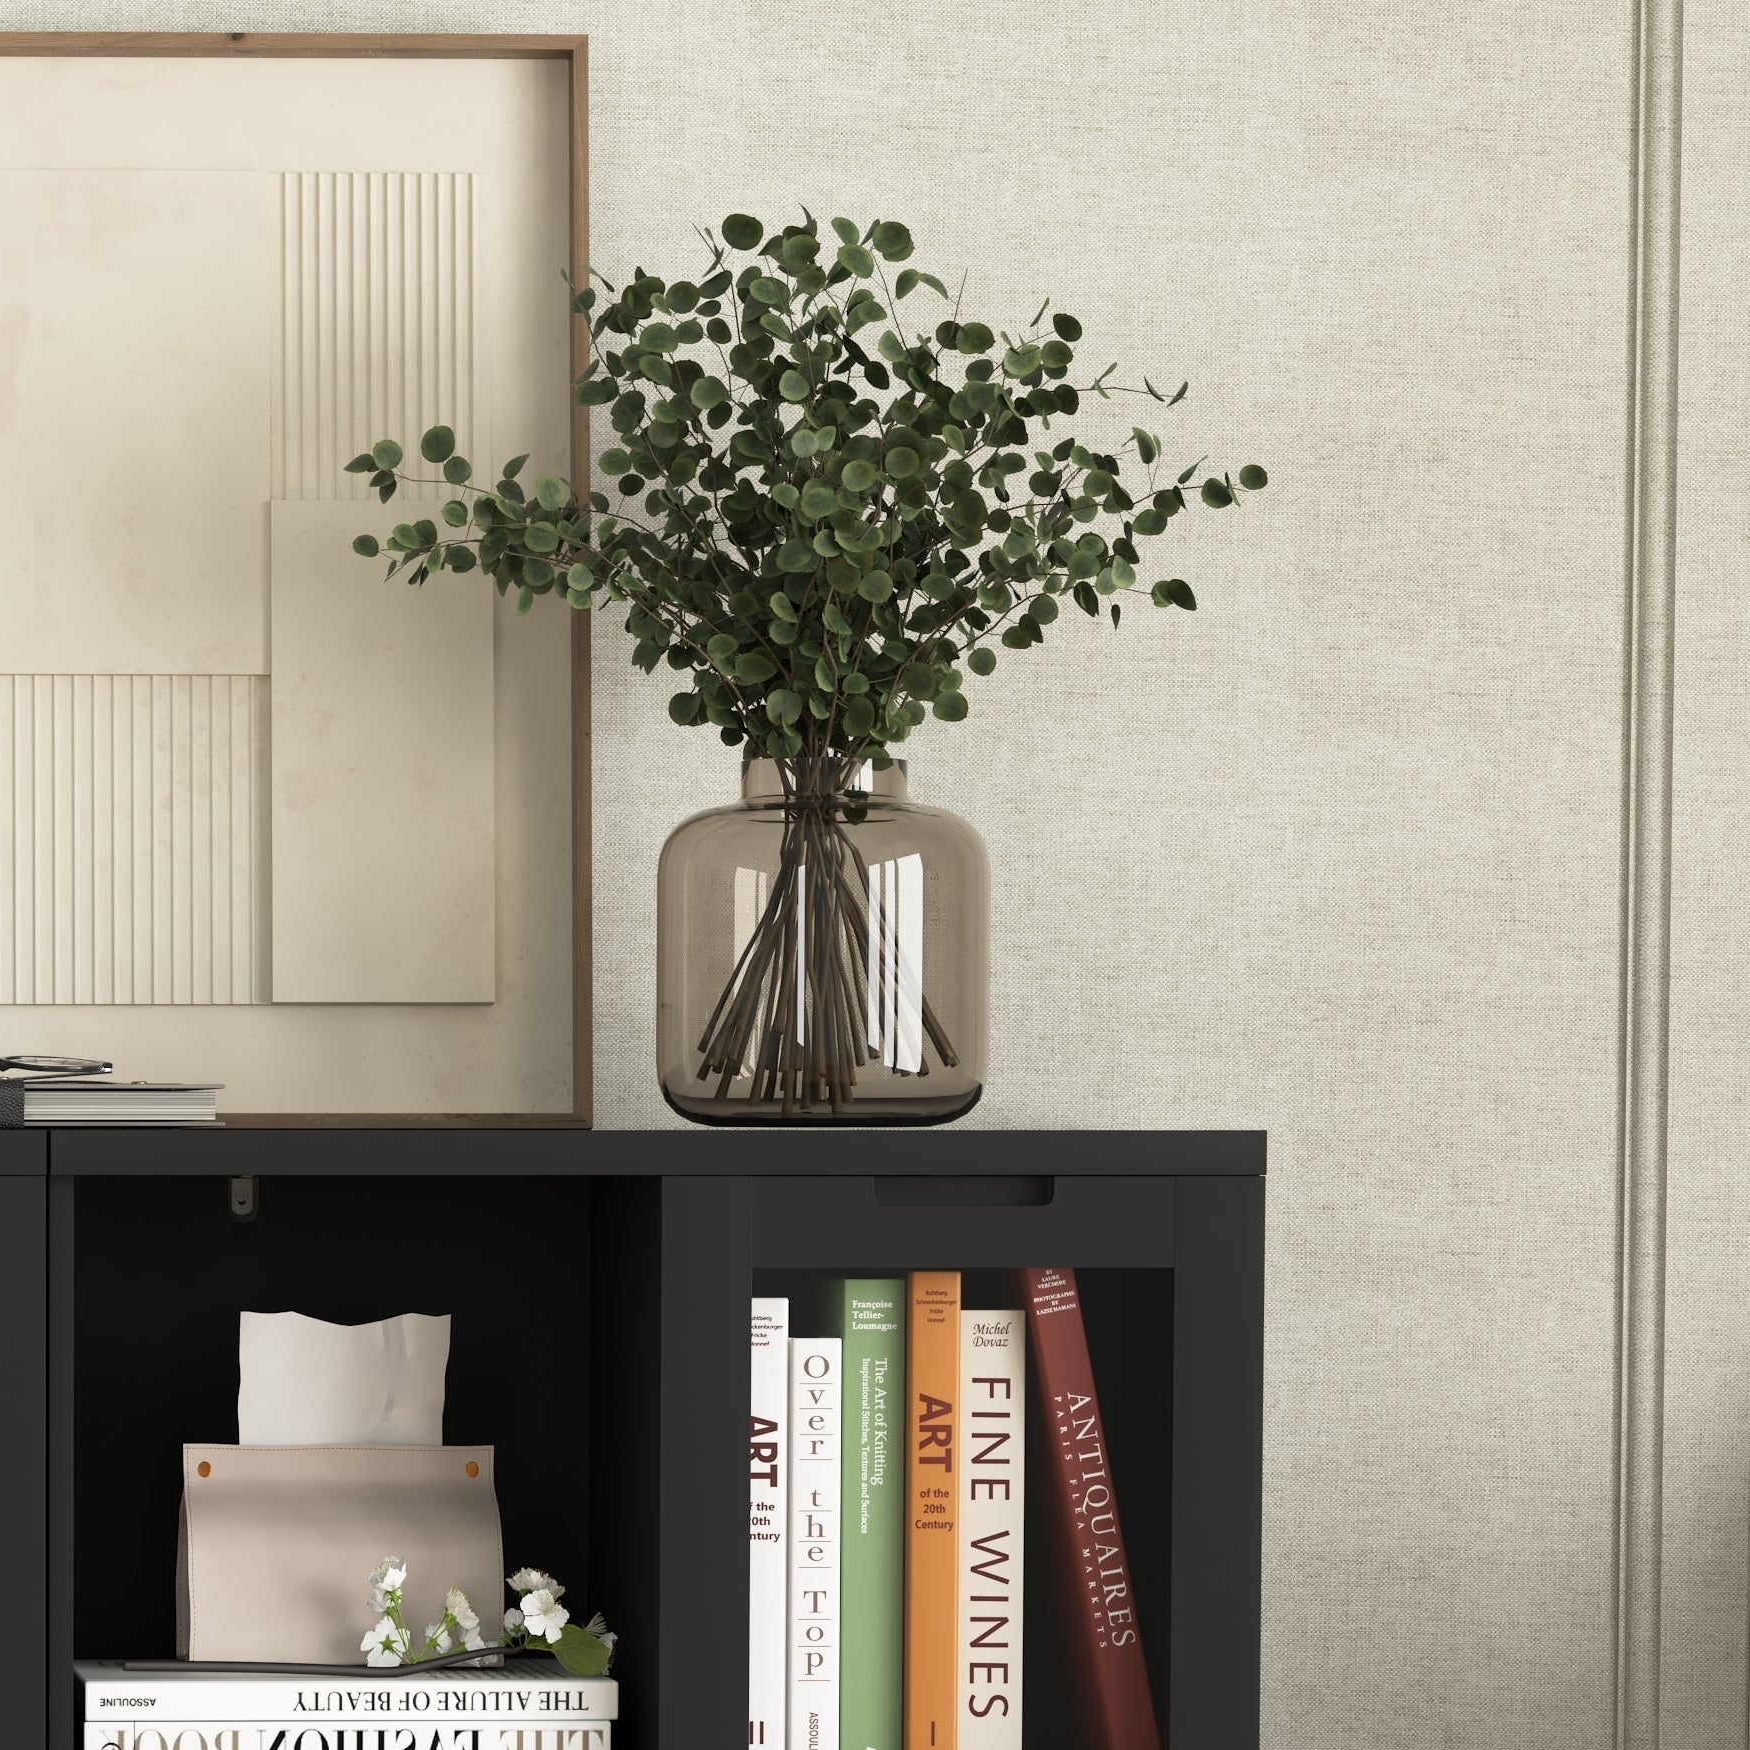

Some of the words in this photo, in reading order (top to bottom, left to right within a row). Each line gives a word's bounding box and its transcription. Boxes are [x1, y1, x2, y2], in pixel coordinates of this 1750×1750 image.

[852, 1300, 893, 1308] Françoise
[1034, 1290, 1075, 1303] PHOTOGRAPHS
[852, 1310, 885, 1319] Tellier-
[852, 1322, 898, 1330] Loumagne
[972, 1322, 1012, 1335] Michel
[972, 1336, 1009, 1348] Dovaz
[875, 1358, 887, 1383] The
[860, 1358, 870, 1409] Inspirational
[804, 1355, 830, 1455] Over
[875, 1387, 887, 1409] Art
[860, 1411, 870, 1444] Stitches,
[875, 1414, 887, 1427] of
[919, 1393, 952, 1473] ART
[970, 1376, 1010, 1501] FINE
[750, 1415, 778, 1488] ART
[870, 1430, 887, 1486] Knitting
[861, 1446, 870, 1481] Textures
[861, 1483, 870, 1498] and
[920, 1488, 931, 1498] of
[932, 1488, 950, 1498] the
[756, 1502, 775, 1510] the
[860, 1500, 870, 1534] Surfaces
[924, 1504, 946, 1514] 20th
[750, 1516, 770, 1526] 0th
[806, 1489, 826, 1562] the
[915, 1519, 954, 1532] Century
[1054, 1396, 1073, 1461] PARIS
[1070, 1479, 1086, 1529] FLEA
[1082, 1548, 1108, 1648] MARKETS
[1067, 1392, 1136, 1647] ANTIQUAIRES
[803, 1591, 826, 1676] Top
[969, 1530, 1010, 1718] WINES
[99, 1698, 156, 1707] ASSOULINE
[292, 1691, 391, 1712] BEAUTY
[398, 1690, 430, 1712] OF
[437, 1690, 532, 1712] ALLURE
[538, 1690, 590, 1712] THE
